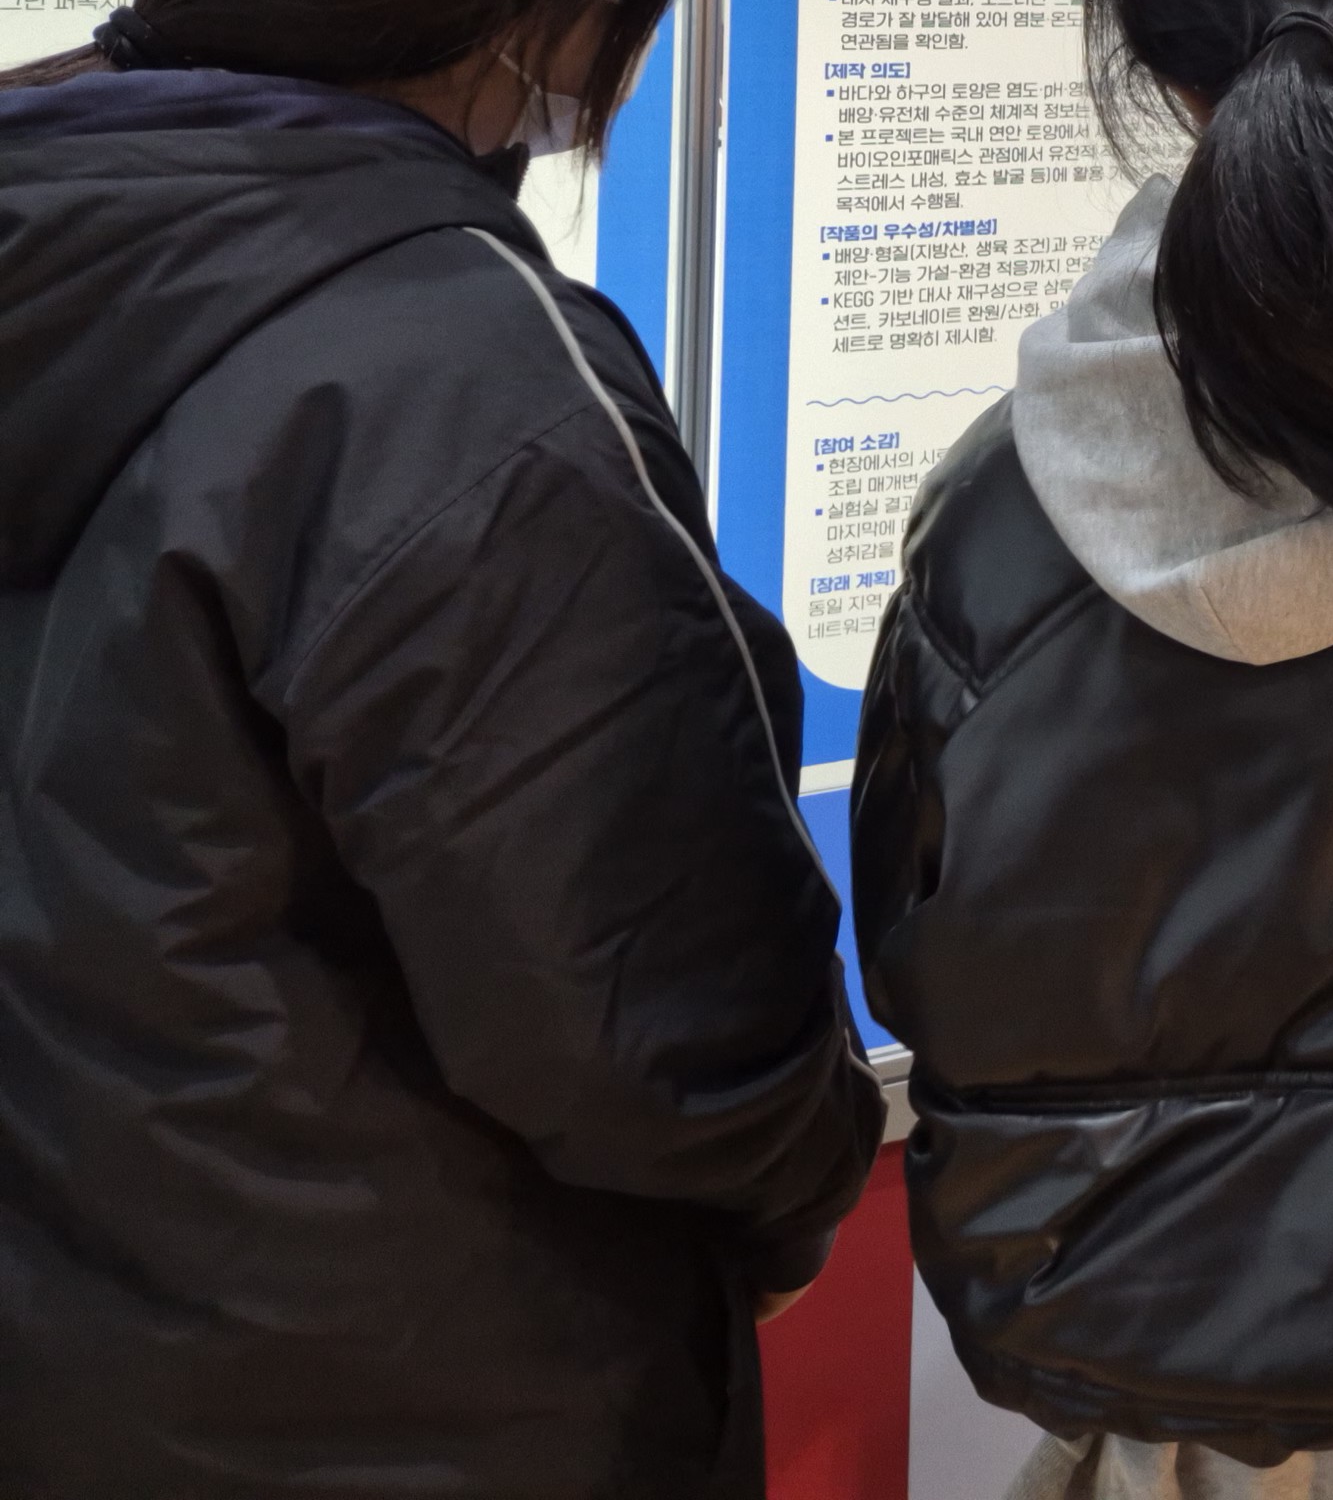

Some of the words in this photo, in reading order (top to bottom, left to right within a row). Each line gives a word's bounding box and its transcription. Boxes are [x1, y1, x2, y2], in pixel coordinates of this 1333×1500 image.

[841, 33, 909, 50] 연관됨을
[915, 33, 968, 50] 확인함.
[825, 62, 865, 80] [제작
[871, 62, 911, 79] 의도]
[839, 85, 891, 101] 바다와
[896, 84, 946, 100] 하구의
[951, 82, 1001, 99] 토양은
[935, 105, 984, 121] 수준의
[990, 103, 1039, 120] 체계적
[978, 146, 1043, 164] 관점에서
[836, 196, 905, 213] 목적에서
[910, 193, 963, 210] 수행됨.
[820, 224, 878, 243] [작품의
[884, 218, 998, 240] 우수성/차별성]
[976, 240, 1008, 257] 생육
[1013, 237, 1067, 255] 조건)과
[834, 267, 911, 287] 제안-기능
[833, 291, 874, 309] KEGG
[880, 288, 913, 307] 기반
[918, 287, 951, 304] 대사
[957, 280, 1038, 301] 재구성으로
[814, 437, 854, 456] [참여
[860, 432, 900, 451] 소감]
[829, 451, 914, 476] 현장에서의
[810, 575, 850, 595] [장래
[856, 570, 895, 589] 계획]
